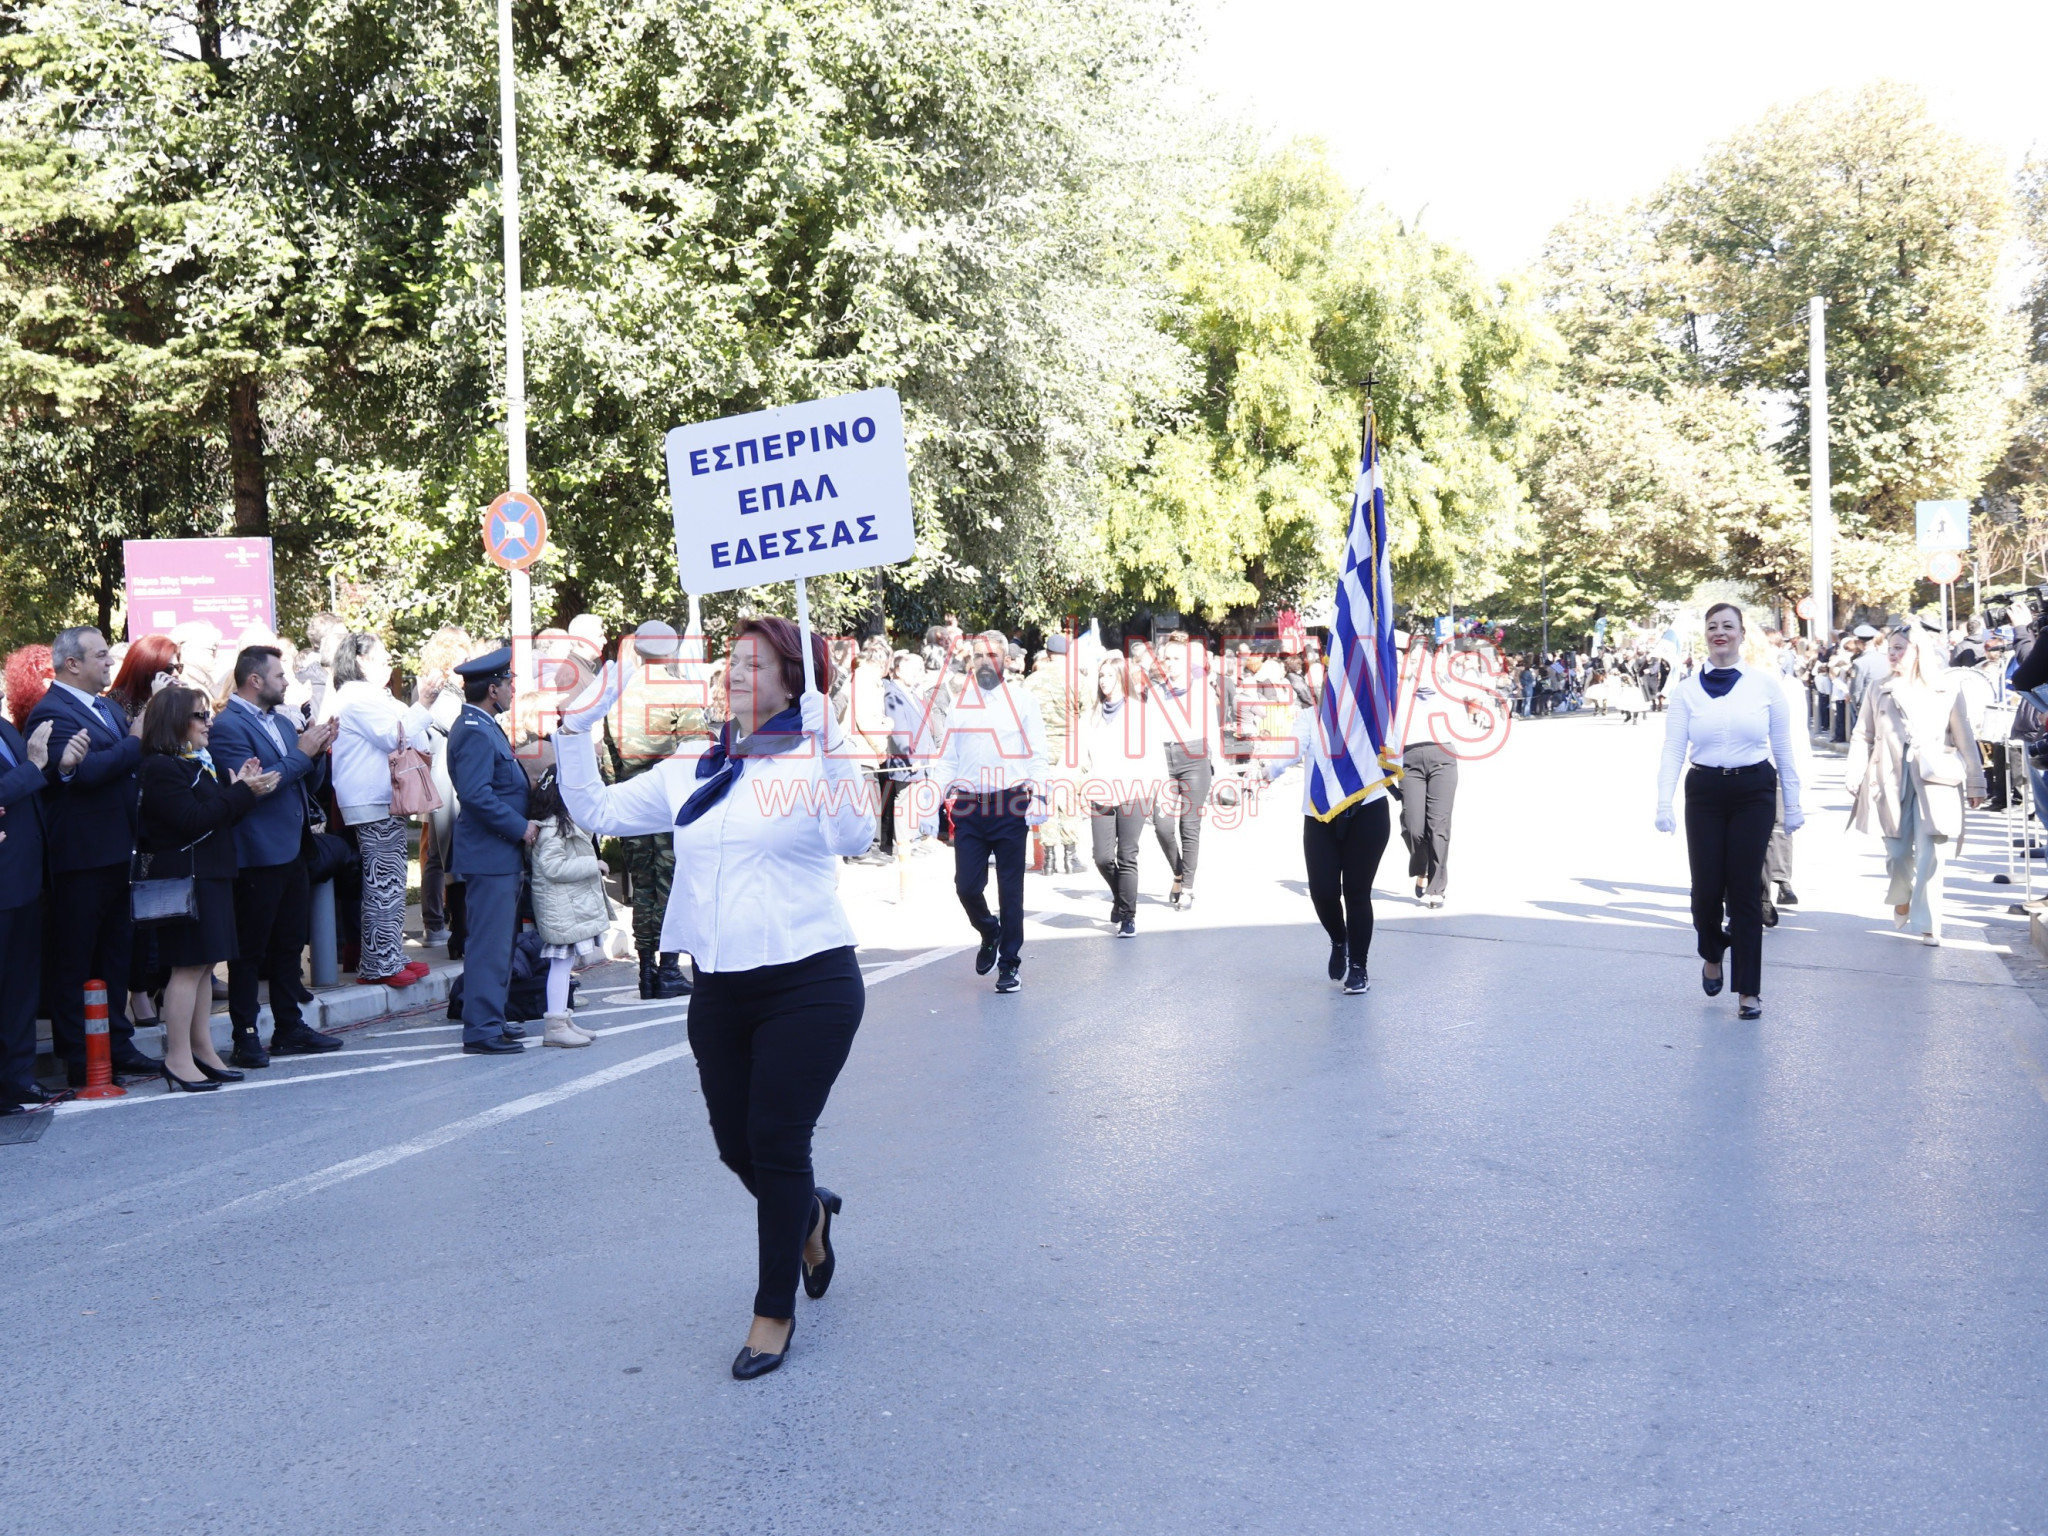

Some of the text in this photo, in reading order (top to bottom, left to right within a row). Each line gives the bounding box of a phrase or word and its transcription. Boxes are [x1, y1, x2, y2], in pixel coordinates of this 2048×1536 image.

[689, 416, 876, 476] ΕΣΠΕΡΙΝΟ
[738, 474, 839, 515] ΕΠΑΛ
[710, 515, 878, 569] ΕΔΕΣΣΑΣ
